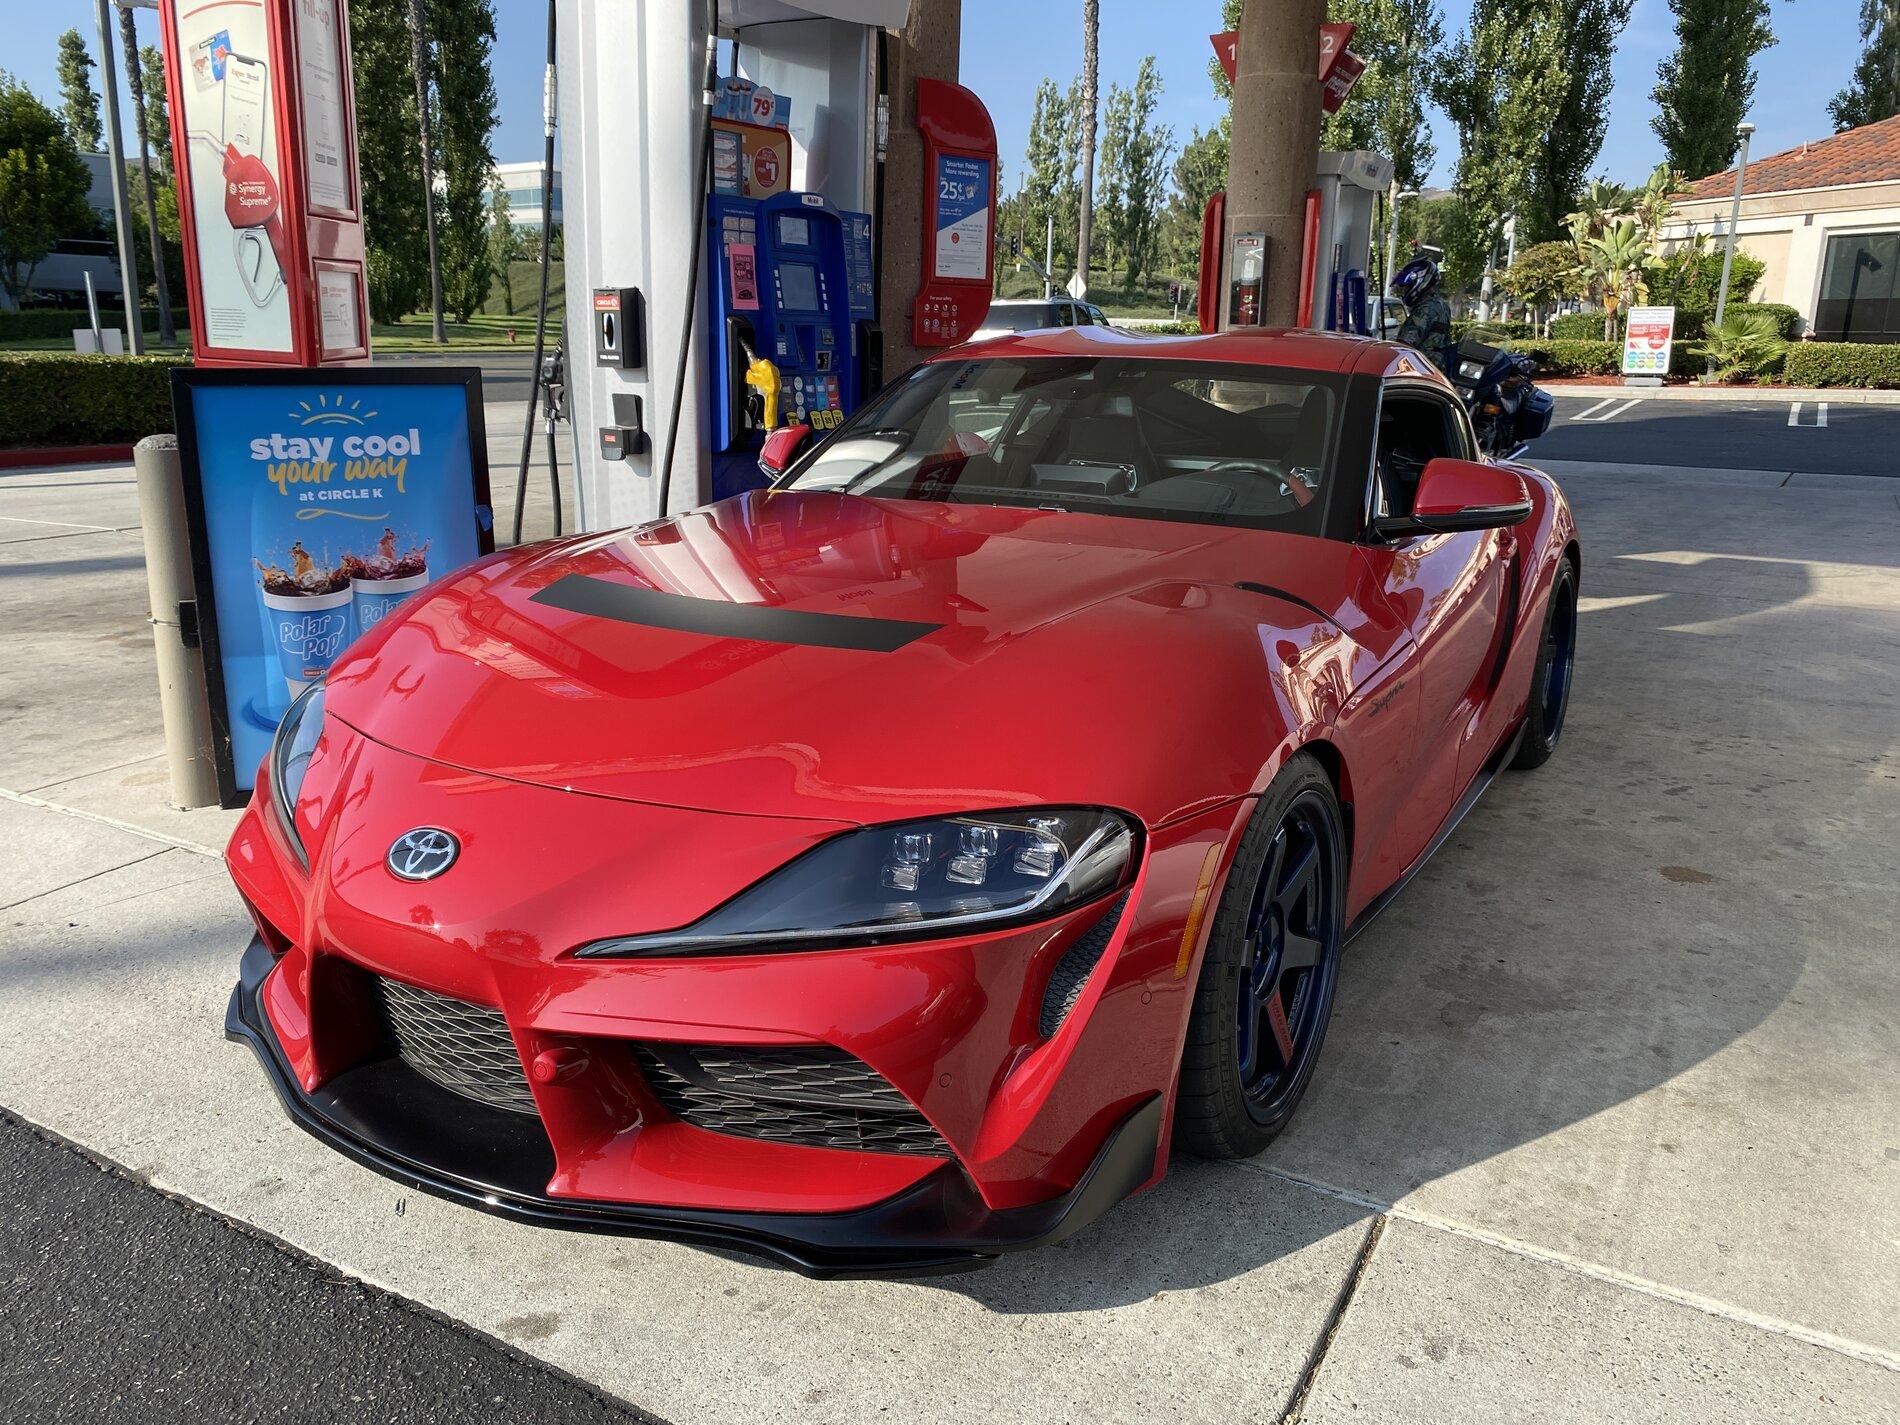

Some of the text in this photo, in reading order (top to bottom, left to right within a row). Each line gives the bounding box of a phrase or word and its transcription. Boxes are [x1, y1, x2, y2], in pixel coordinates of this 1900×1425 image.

[1227, 44, 1236, 60] 1
[1323, 36, 1334, 54] 2
[238, 184, 266, 195] Synergy
[863, 224, 870, 239] 4
[250, 428, 421, 463] stay cool
[267, 455, 408, 496] your way
[299, 487, 383, 501] at CIRCLE K
[279, 615, 331, 643] Polar
[302, 631, 341, 661] Pop
